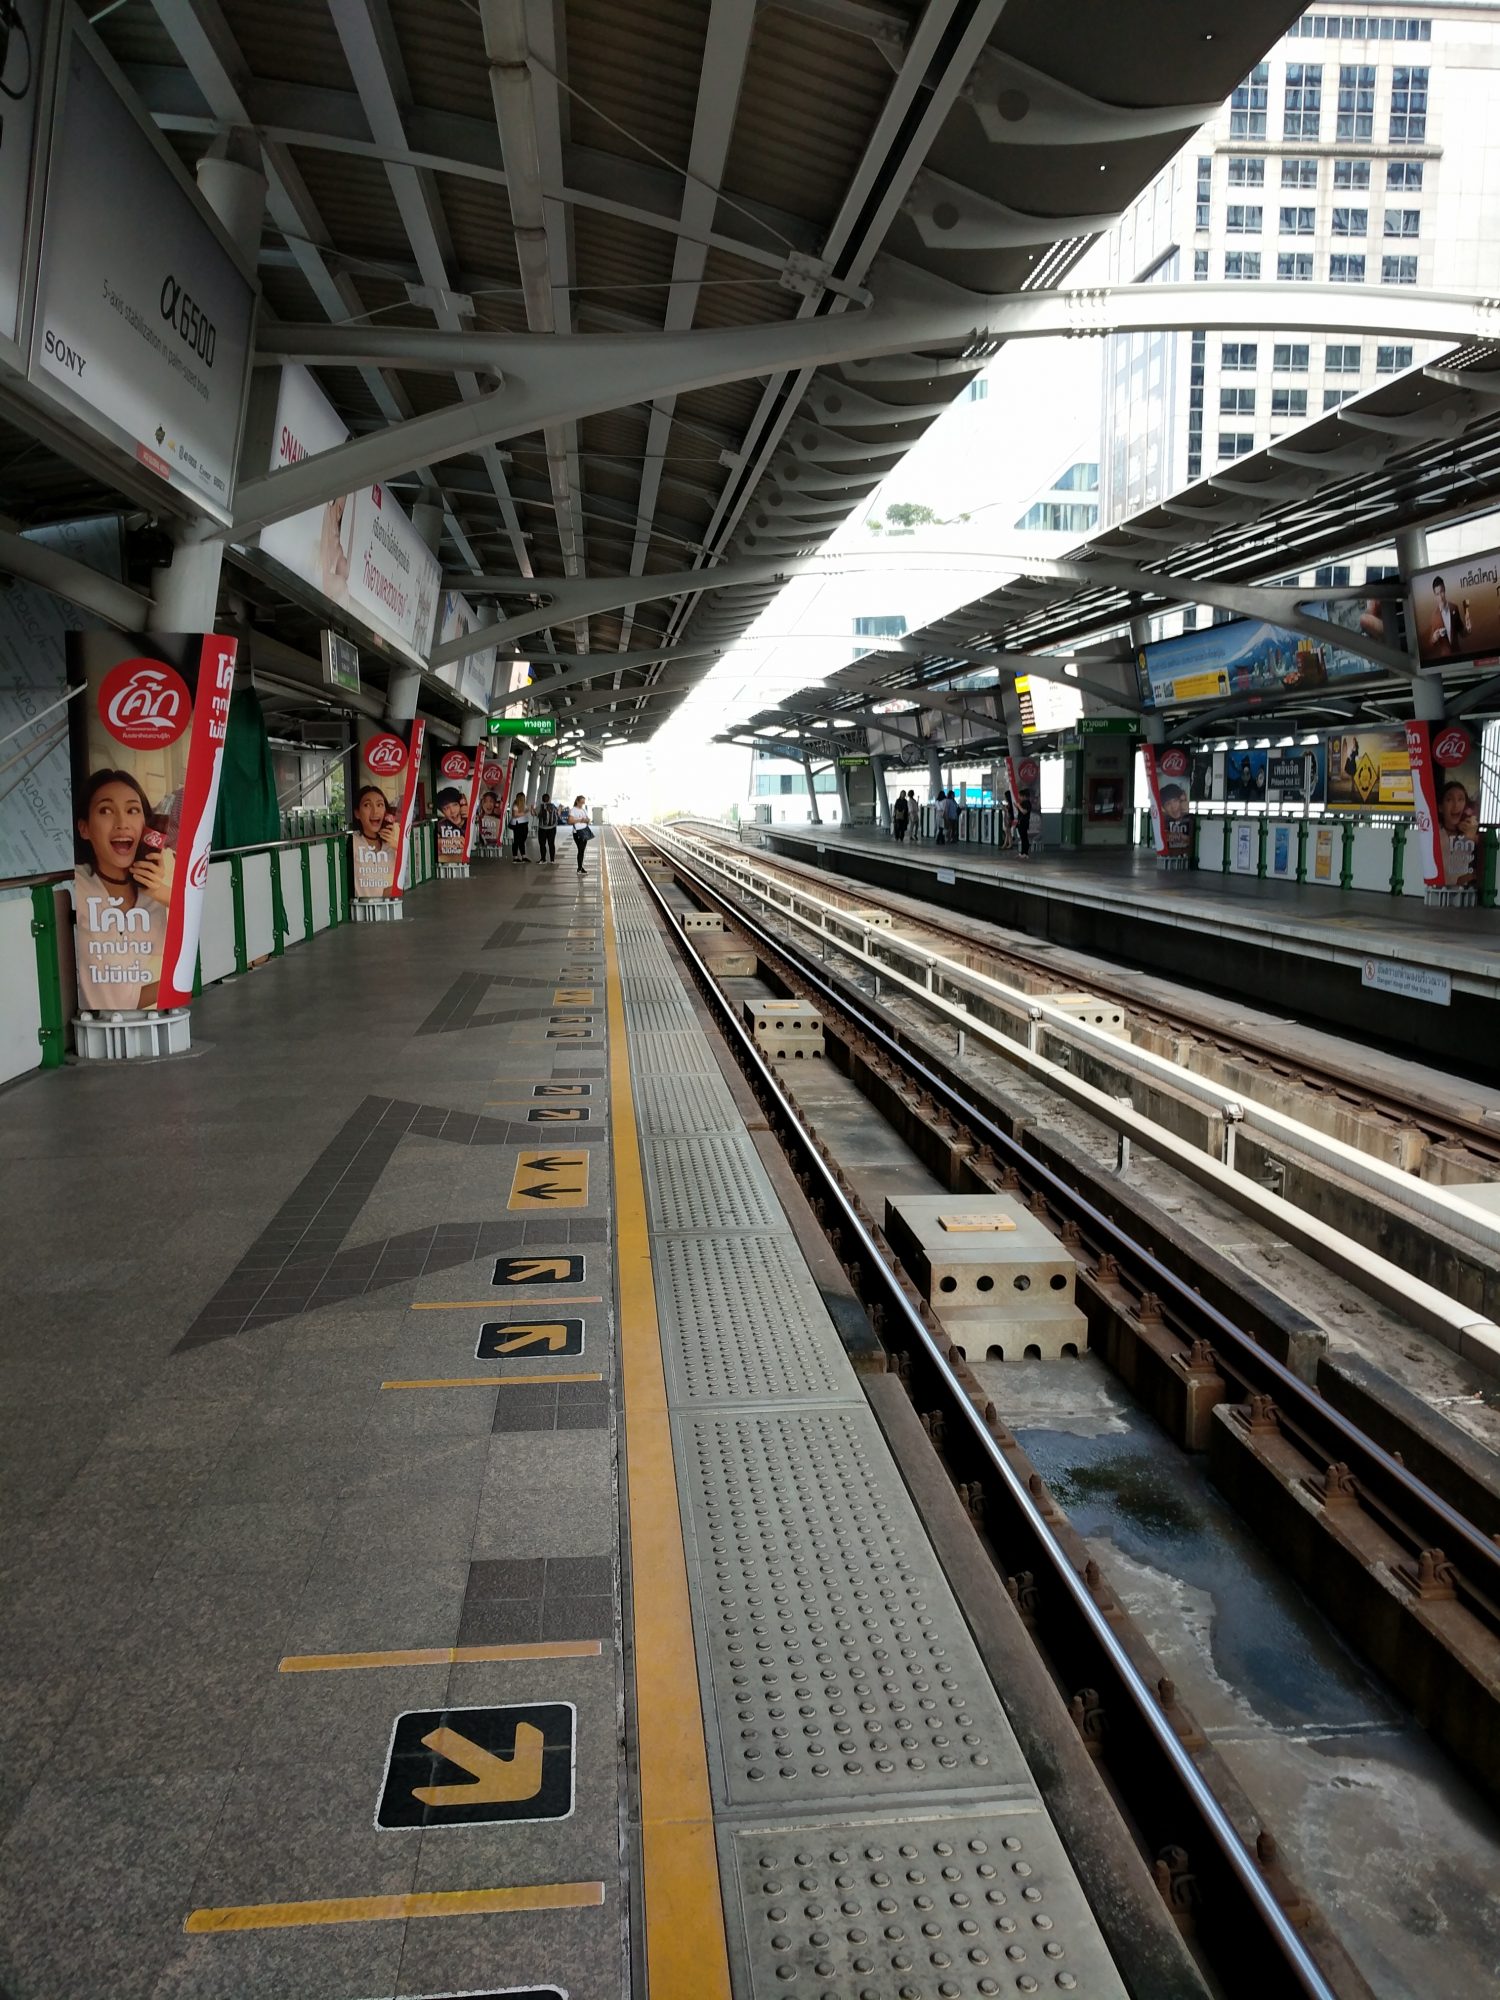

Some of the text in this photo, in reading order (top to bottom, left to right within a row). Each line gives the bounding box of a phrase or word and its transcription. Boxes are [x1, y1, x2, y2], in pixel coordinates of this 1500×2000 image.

[44, 330, 87, 378] SONY
[1460, 565, 1498, 588] เกล็ดใหญ่
[524, 720, 552, 728] ทางออก
[441, 825, 461, 838] โค้ก
[358, 845, 388, 863] โค้ก
[86, 896, 150, 933] โค้ก
[89, 936, 152, 960] ทุกบ่าย
[89, 961, 153, 984] ไม่มีเบื่อ
